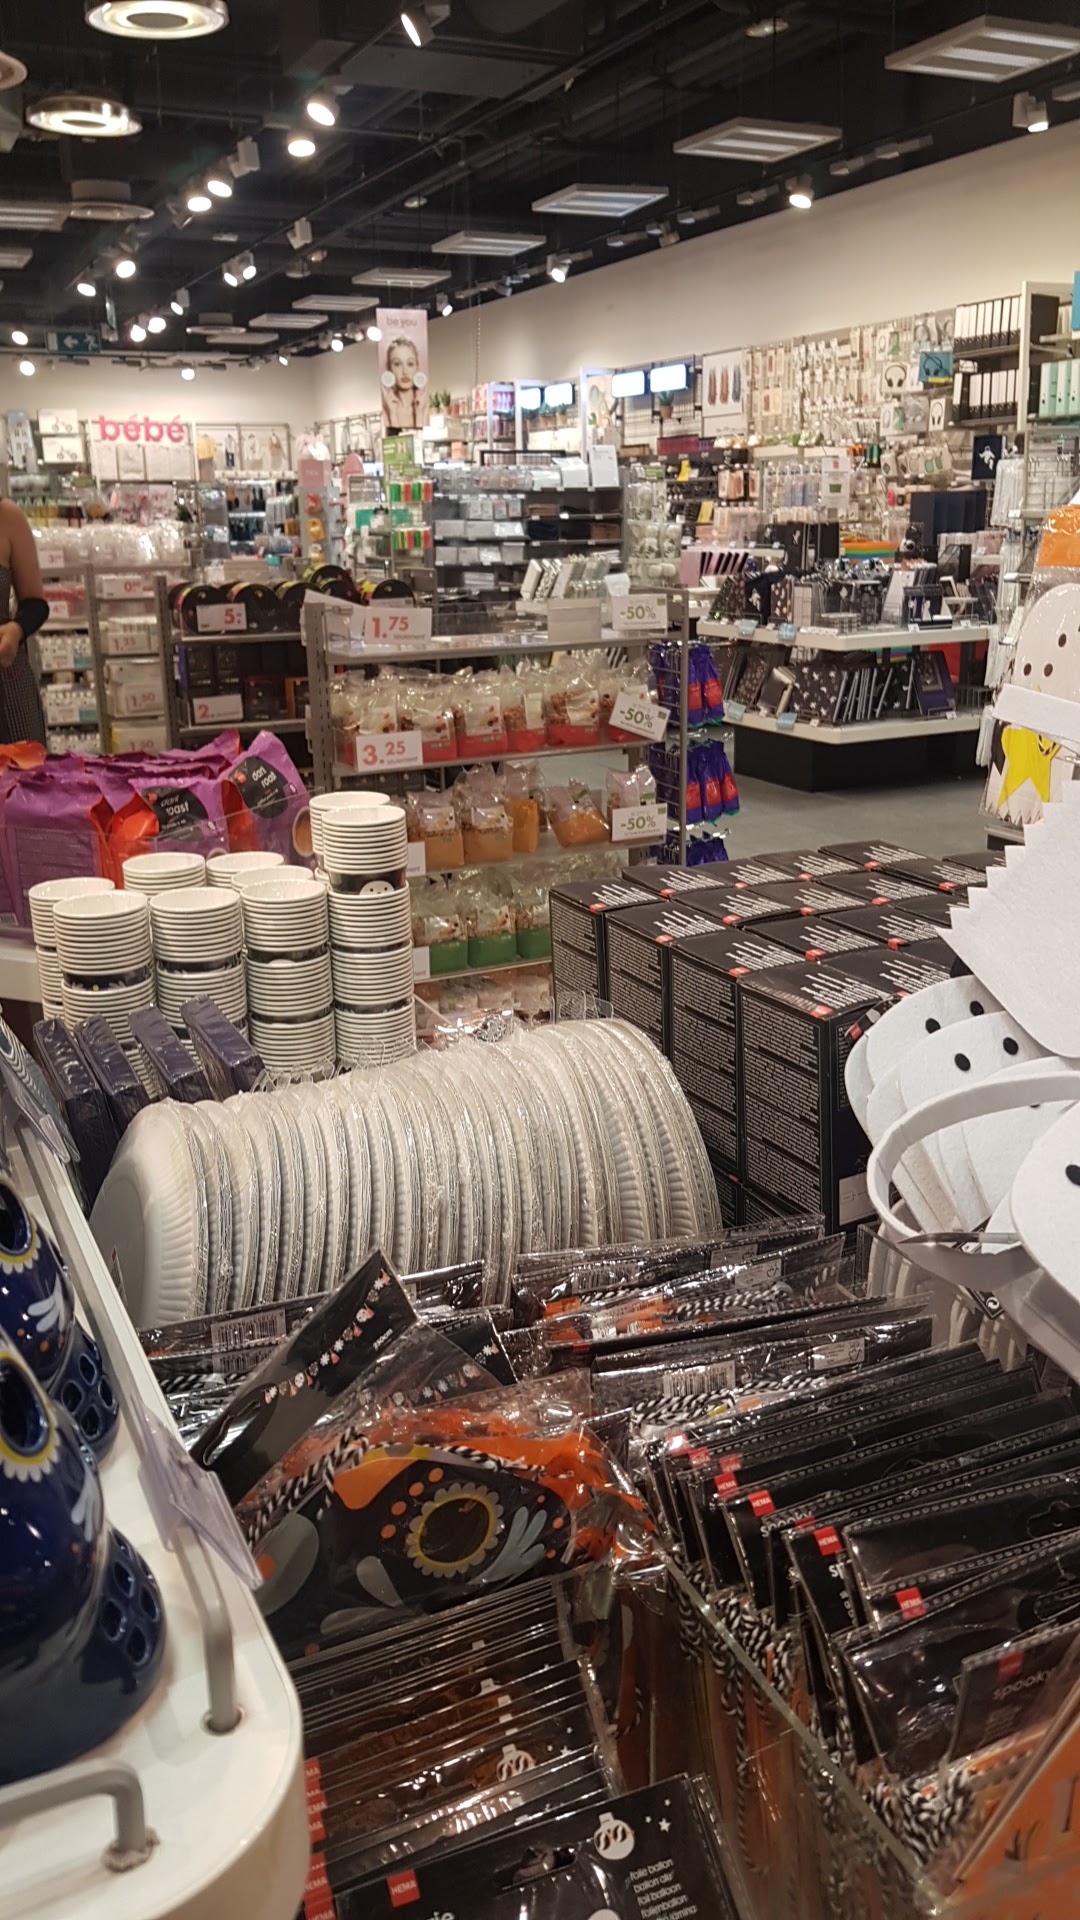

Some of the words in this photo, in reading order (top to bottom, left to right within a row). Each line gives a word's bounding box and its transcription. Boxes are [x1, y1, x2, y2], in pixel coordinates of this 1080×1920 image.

[386, 315, 399, 326] be
[400, 318, 418, 329] you
[98, 413, 185, 443] bébé
[620, 604, 656, 620] -50%
[371, 615, 409, 639] 1.75
[620, 707, 653, 729] -50%
[362, 740, 406, 766] 3.25
[620, 815, 656, 831] -50%
[717, 1480, 737, 1490] HEMA
[751, 1497, 771, 1508] HEMA
[818, 1535, 839, 1547] HEMA
[900, 1597, 922, 1610] HEMA
[390, 1879, 417, 1896] HEMA
[650, 1883, 682, 1901] balloon
